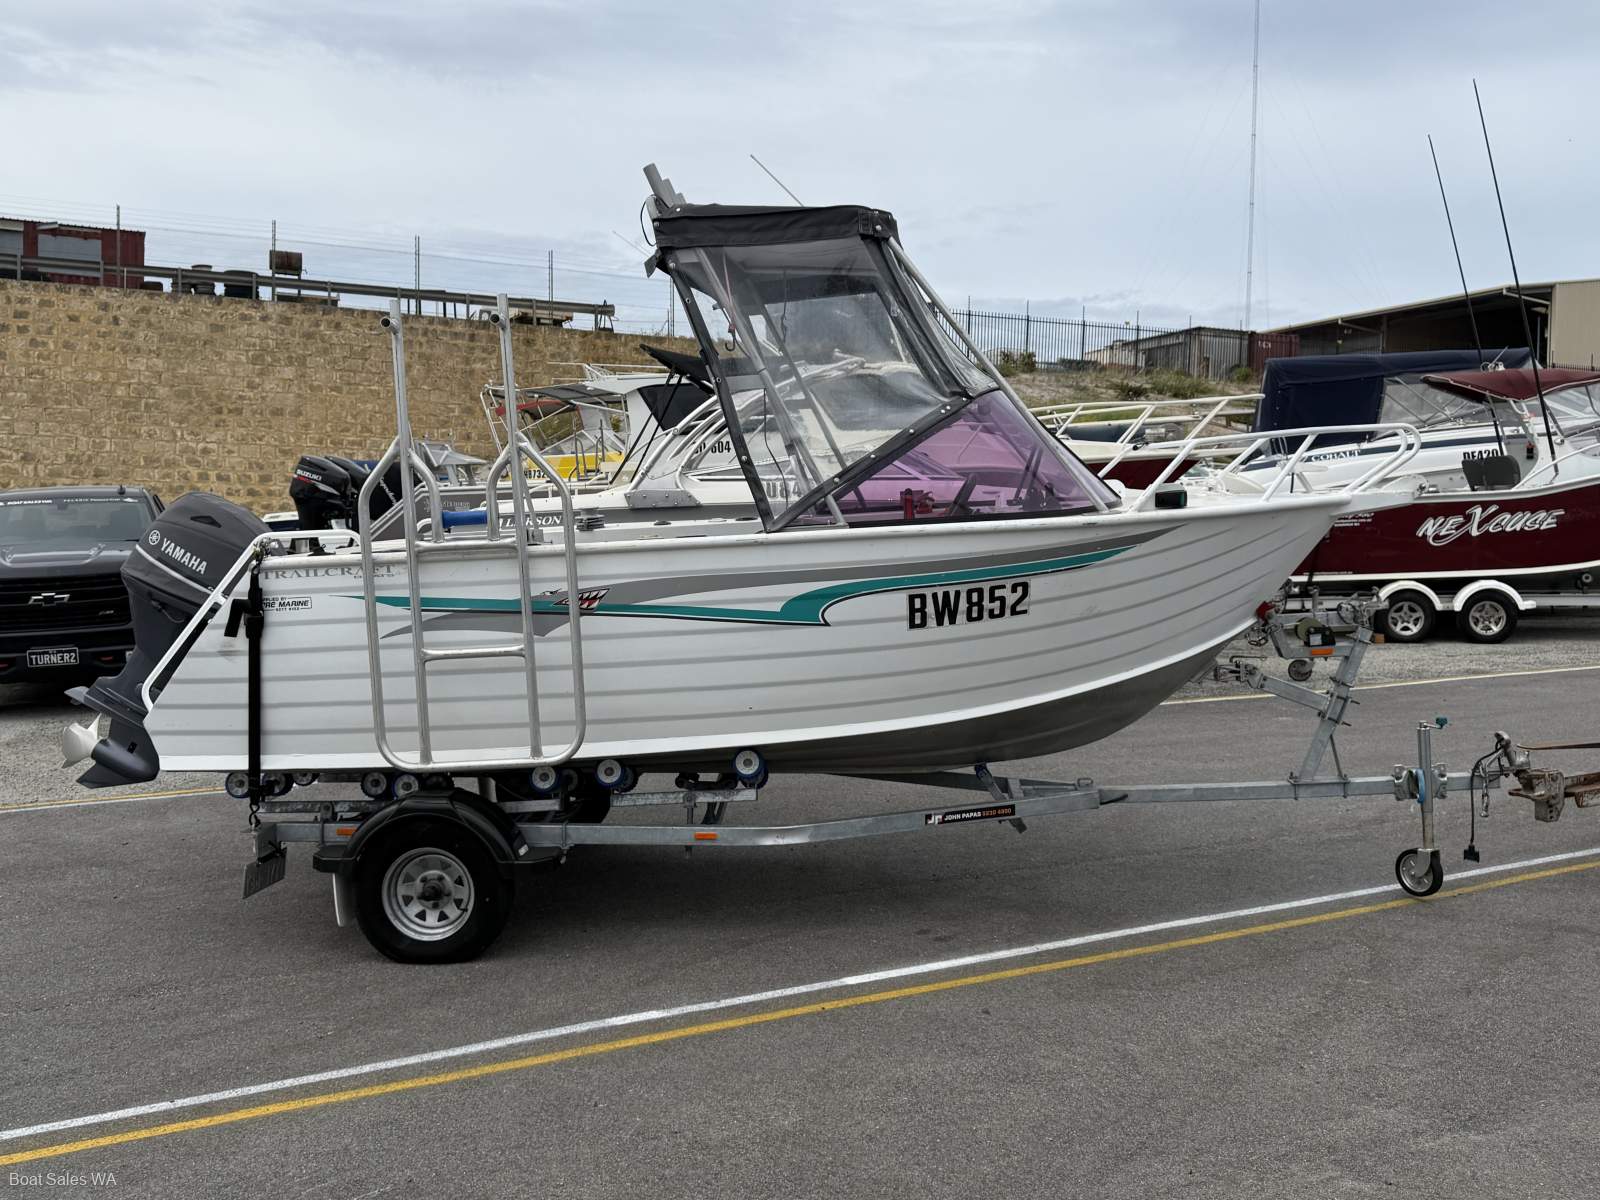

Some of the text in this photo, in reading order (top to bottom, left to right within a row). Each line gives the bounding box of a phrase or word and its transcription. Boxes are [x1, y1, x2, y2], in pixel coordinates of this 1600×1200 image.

[505, 515, 562, 528] LRSON
[161, 538, 208, 575] YAMAHA
[278, 600, 309, 608] MARINE
[908, 581, 1029, 629] BW852
[30, 652, 77, 665] TURNER2
[962, 811, 982, 819] PAPAS
